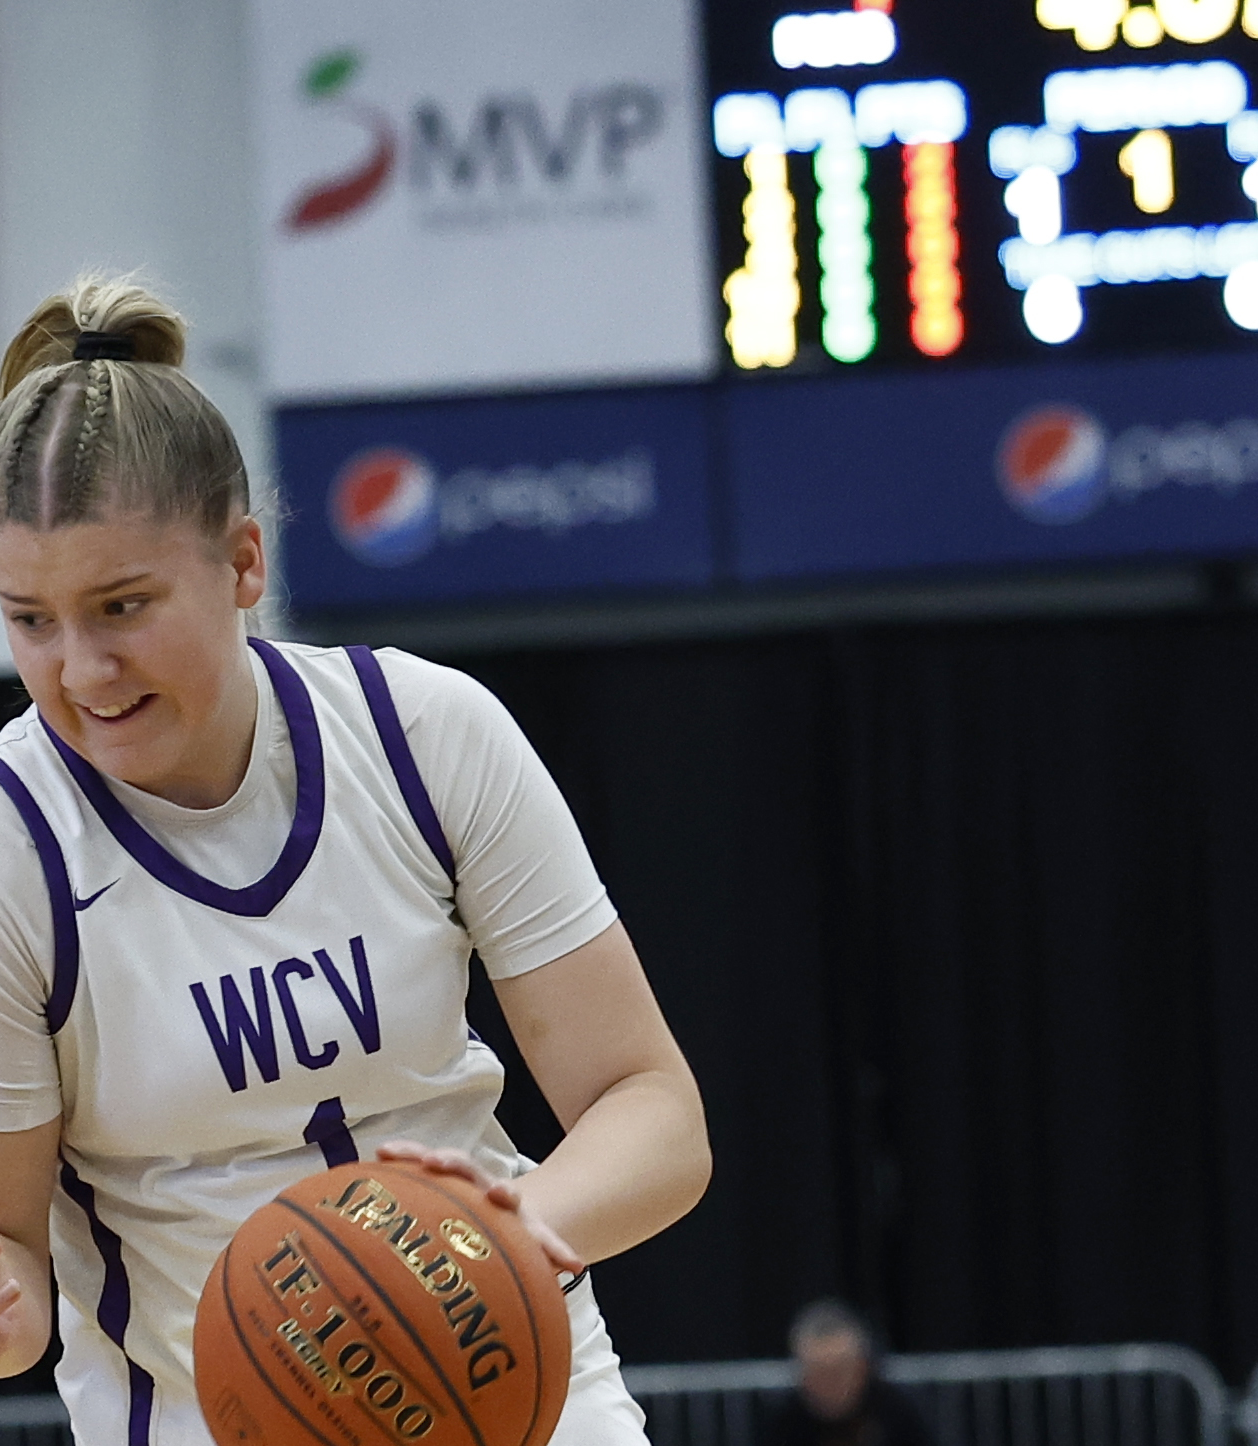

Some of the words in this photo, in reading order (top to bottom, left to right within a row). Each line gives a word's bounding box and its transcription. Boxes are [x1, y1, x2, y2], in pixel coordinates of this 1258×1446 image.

[409, 80, 662, 188] MVP
[1106, 420, 1258, 500] pep
[188, 935, 381, 1092] WCV
[303, 1097, 359, 1169] 1
[317, 1178, 517, 1391] SPALDING
